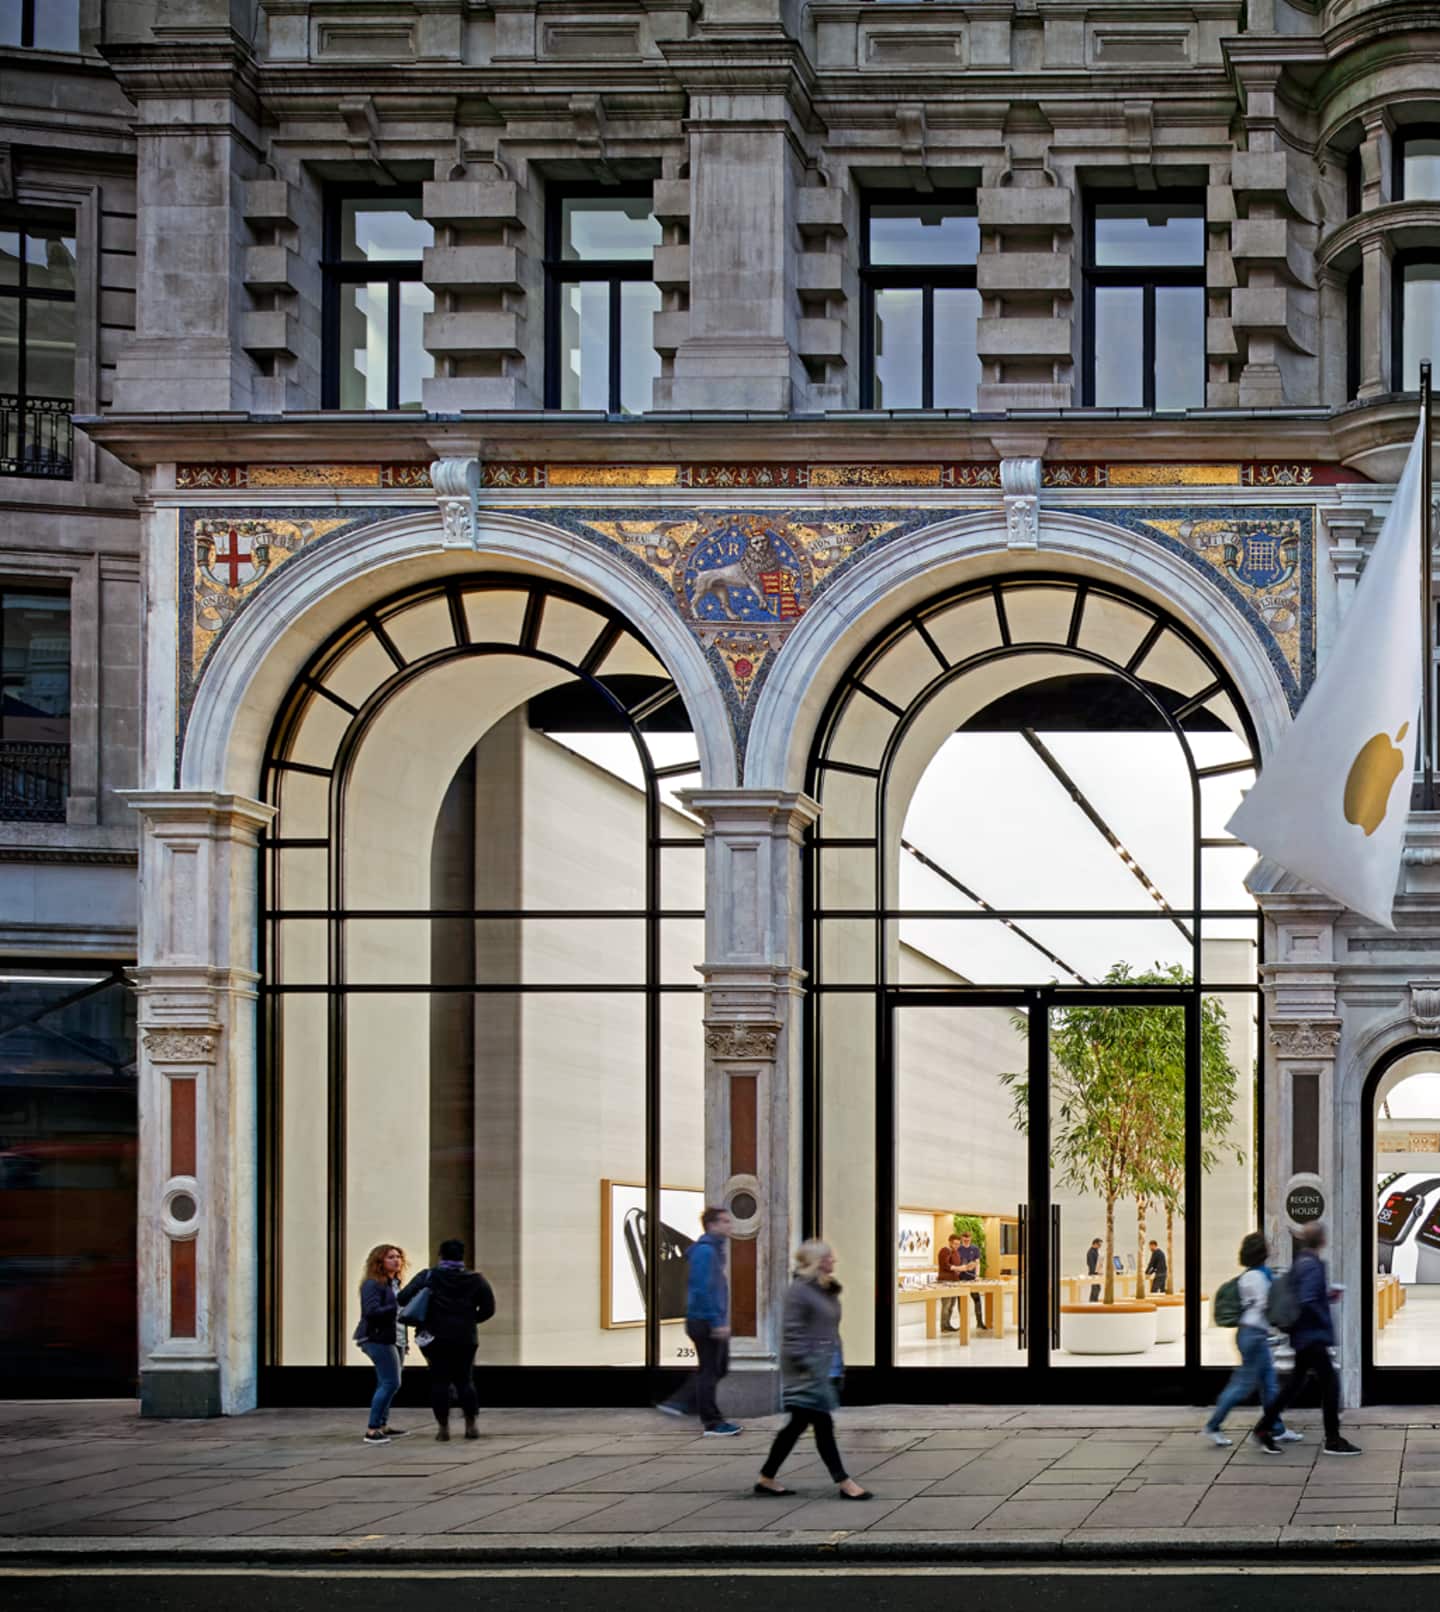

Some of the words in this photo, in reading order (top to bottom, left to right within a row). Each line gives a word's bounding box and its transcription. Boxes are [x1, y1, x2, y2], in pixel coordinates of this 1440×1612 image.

[717, 542, 740, 556] VR
[1291, 1207, 1319, 1216] HOUSE
[676, 1347, 696, 1358] 235
